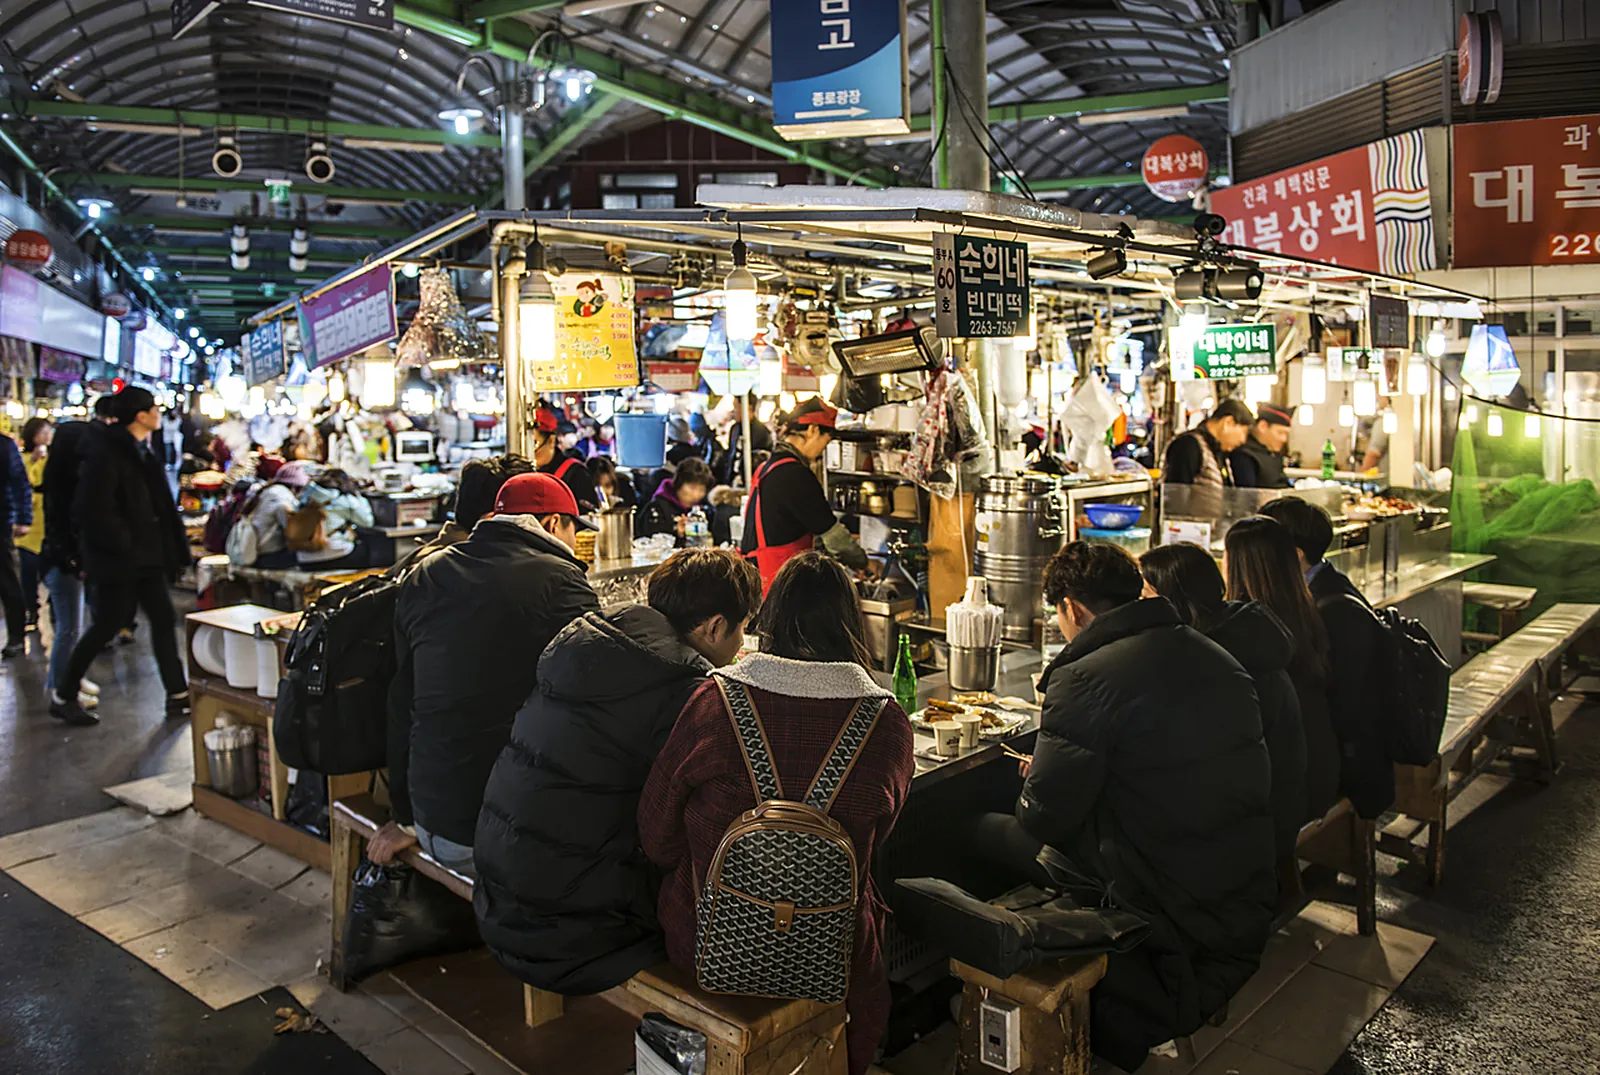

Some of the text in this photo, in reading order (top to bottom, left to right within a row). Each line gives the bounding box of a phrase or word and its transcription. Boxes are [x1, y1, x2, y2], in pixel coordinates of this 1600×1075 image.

[1563, 124, 1600, 151] 과
[1145, 150, 1203, 175] 대복상회
[959, 242, 1025, 287] 순희네
[937, 267, 954, 290] 60
[942, 297, 951, 313] 호
[967, 291, 1022, 318] 빈대떡
[970, 321, 1016, 335] 2263-7567
